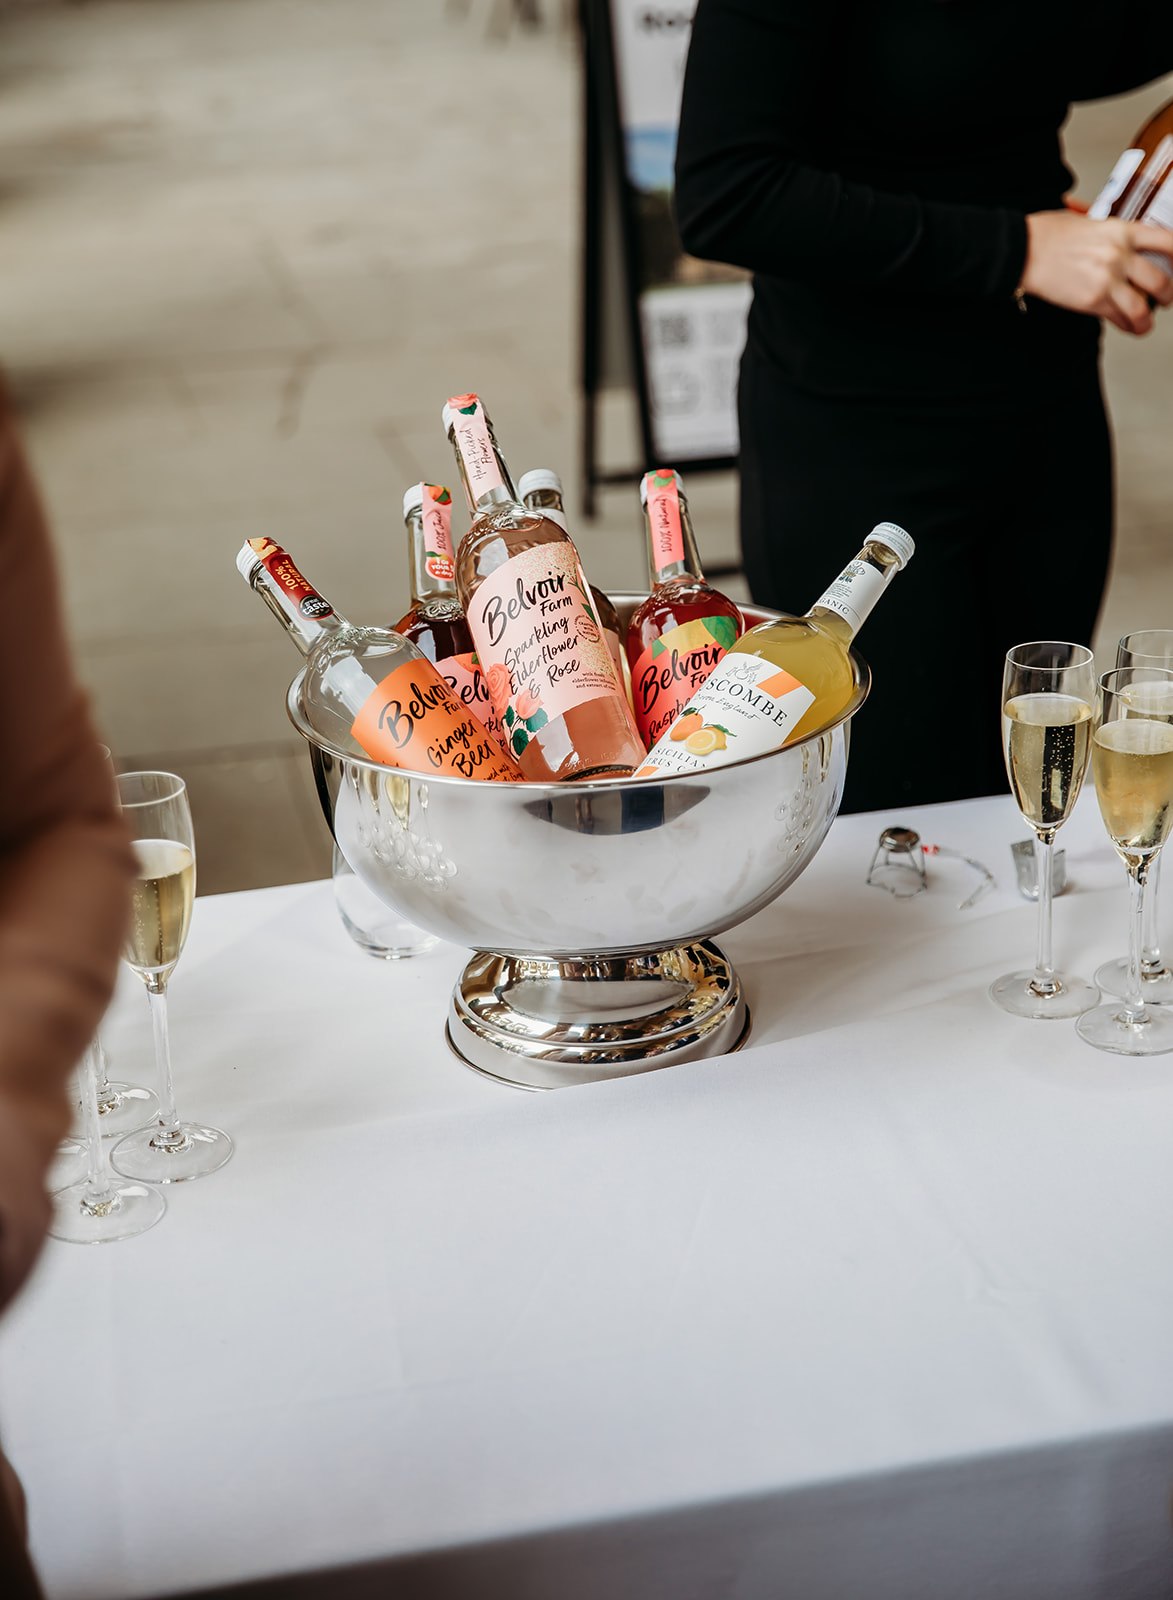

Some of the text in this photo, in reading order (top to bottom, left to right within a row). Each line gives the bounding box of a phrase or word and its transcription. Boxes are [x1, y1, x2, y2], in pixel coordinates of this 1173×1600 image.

[655, 498, 673, 553] 100% Natural
[275, 565, 299, 590] 100%
[282, 559, 313, 592] NATURAL
[302, 601, 329, 615] taste
[482, 571, 566, 647] Belvoir
[540, 595, 573, 617] Farm
[504, 616, 569, 673] Sparkling
[510, 634, 579, 695] Elderflower
[546, 657, 580, 688] Rose
[639, 643, 722, 715] Belvoir
[705, 678, 788, 727] SCOMBE
[427, 719, 478, 768] Ginger
[451, 740, 495, 777] Beer
